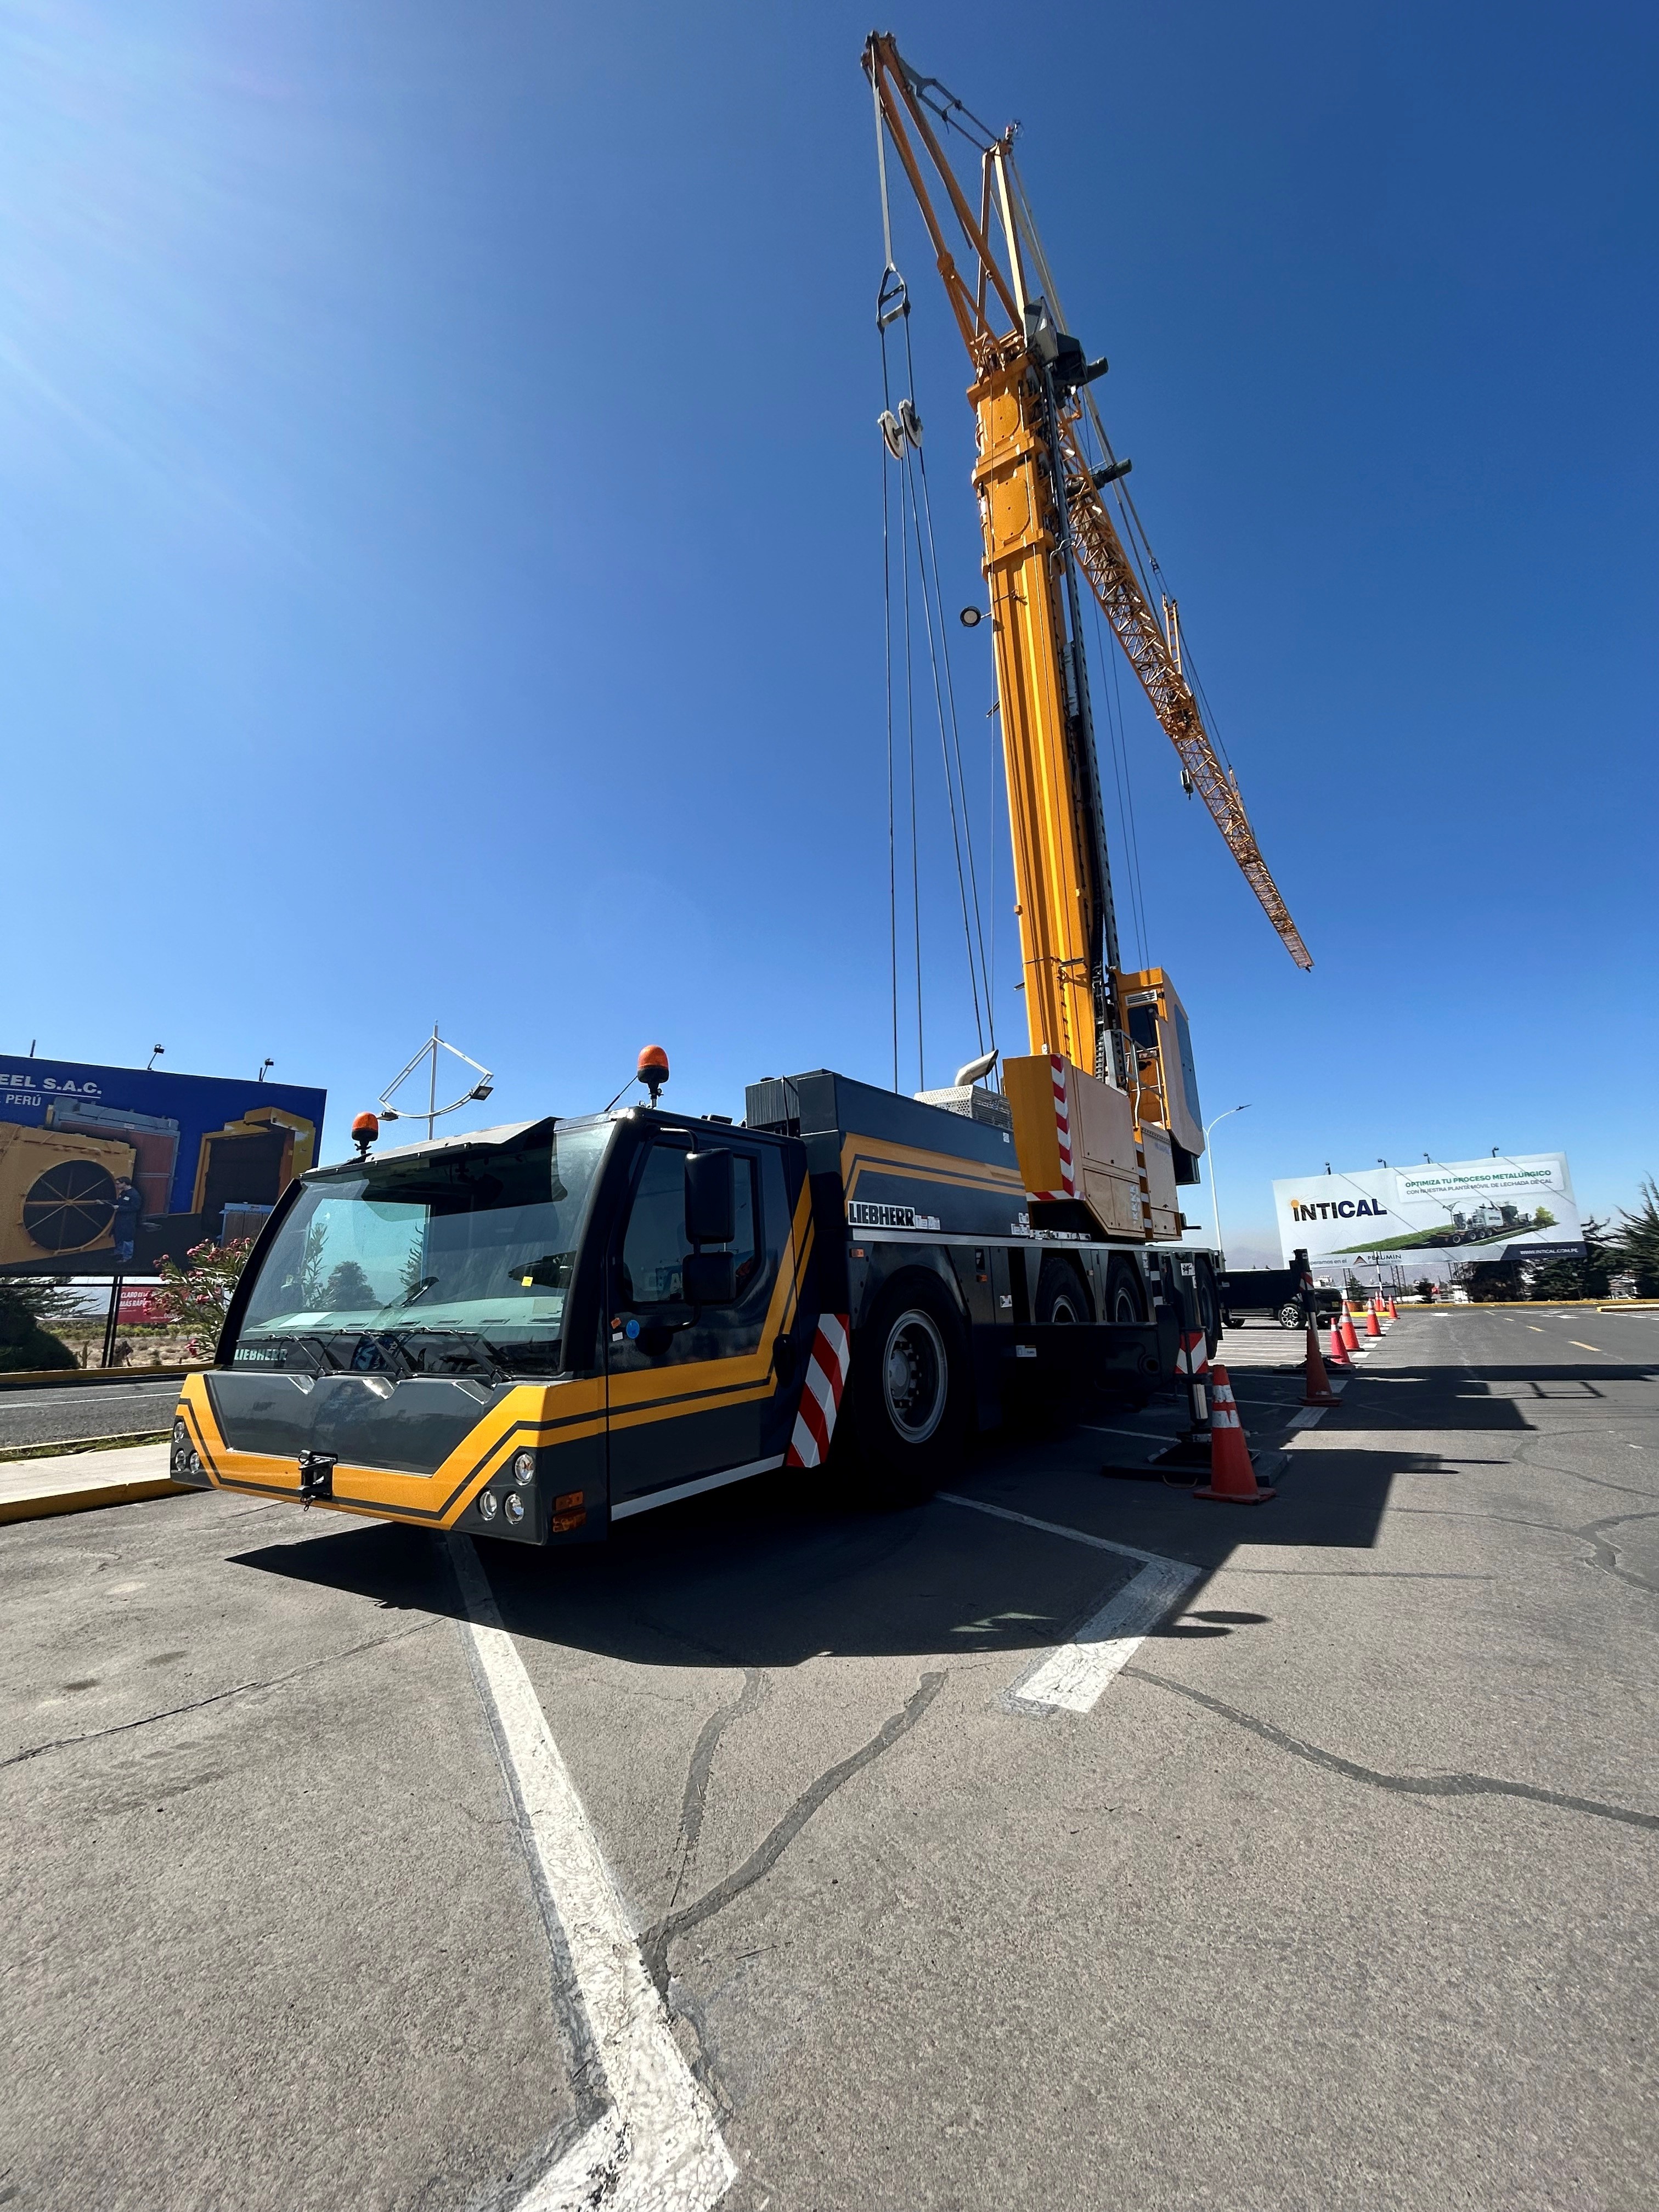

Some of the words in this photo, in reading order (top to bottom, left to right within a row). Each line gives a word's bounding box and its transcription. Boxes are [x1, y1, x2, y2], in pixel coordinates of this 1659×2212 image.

[43, 1078, 103, 1094] S.A.C.
[5, 1094, 41, 1106] PERÚ
[1492, 1170, 1551, 1180] METALÚRGICO
[850, 1203, 915, 1227] LIEBHERR
[235, 1348, 288, 1361] LIEBHERR
